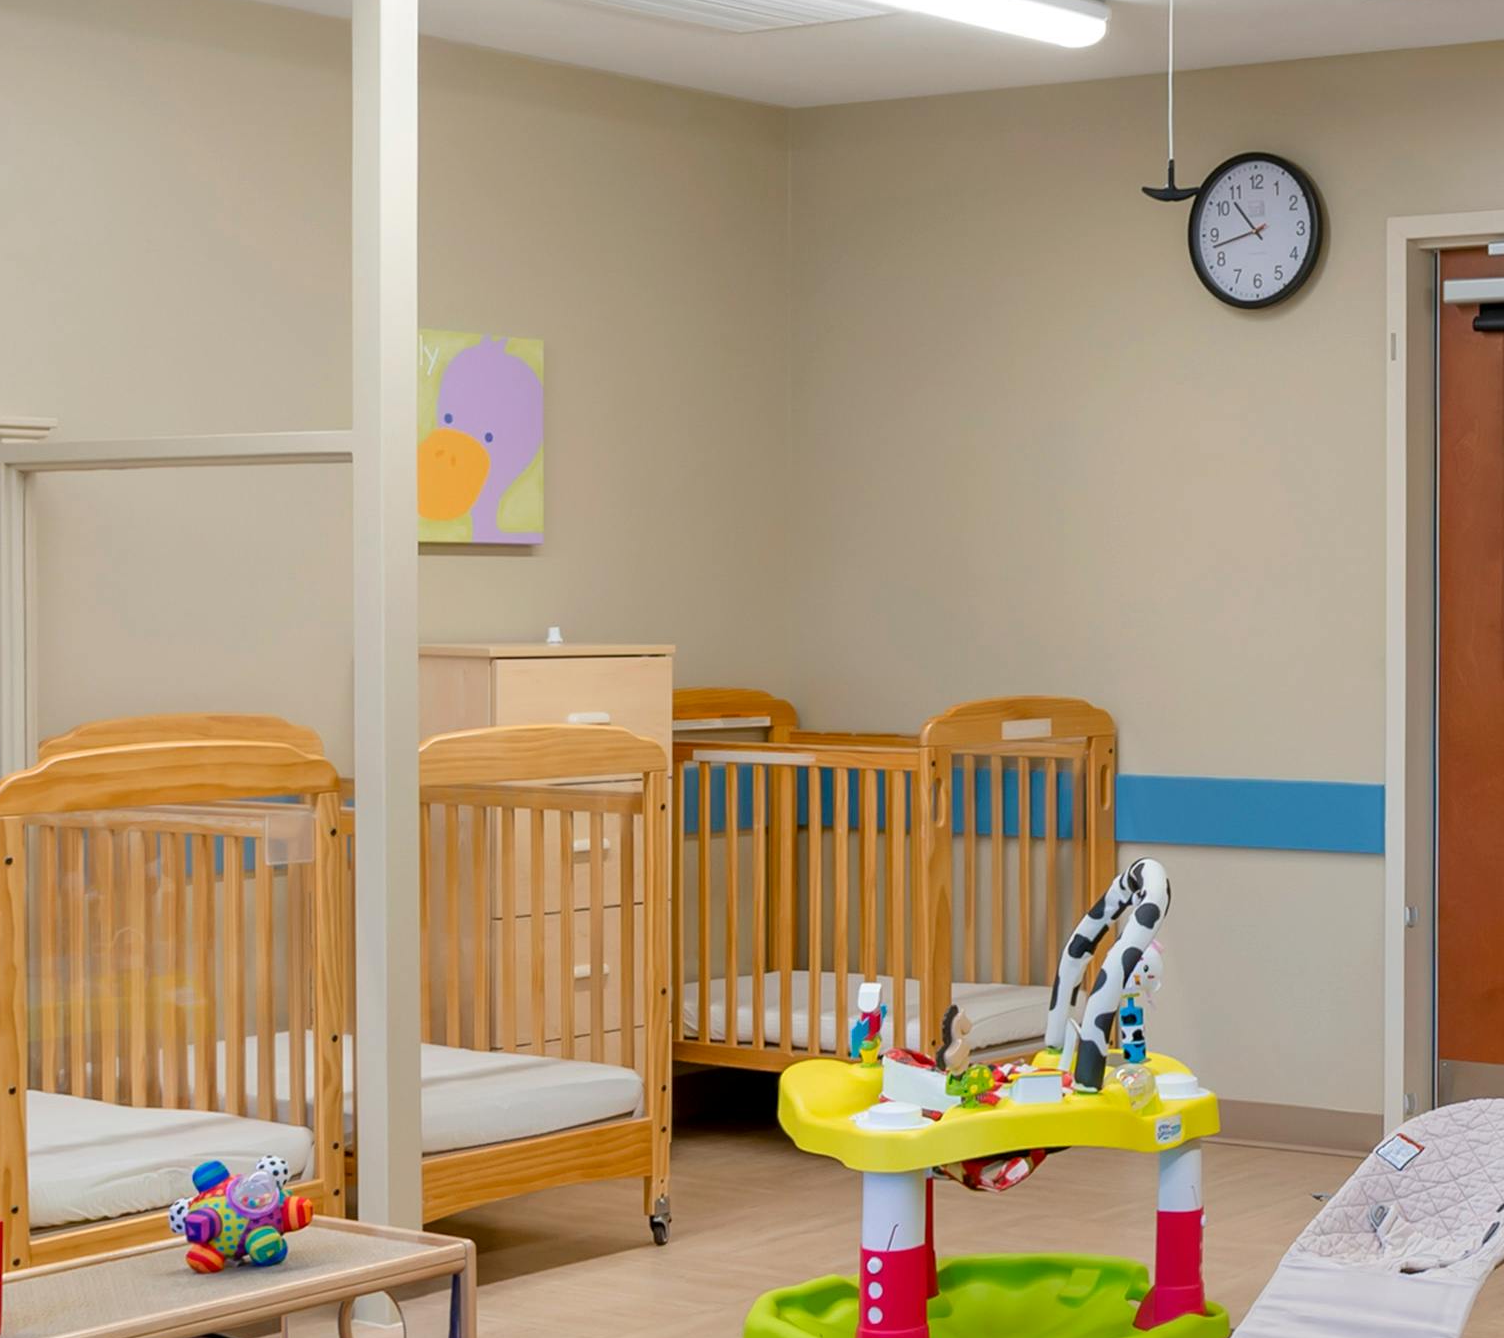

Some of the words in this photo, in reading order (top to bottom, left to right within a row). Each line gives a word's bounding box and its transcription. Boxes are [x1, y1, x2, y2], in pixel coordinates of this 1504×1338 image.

[1249, 173, 1264, 190] 12
[1273, 181, 1280, 196] 1
[1229, 184, 1242, 200] 11
[1216, 201, 1230, 216] 10
[1289, 195, 1298, 211] 2
[1210, 228, 1219, 242] 9
[1296, 221, 1306, 236] 3
[1217, 252, 1226, 267] 8
[1289, 246, 1298, 261] 4
[1233, 268, 1242, 284] 7
[1274, 265, 1284, 281] 5
[1252, 273, 1263, 289] 6
